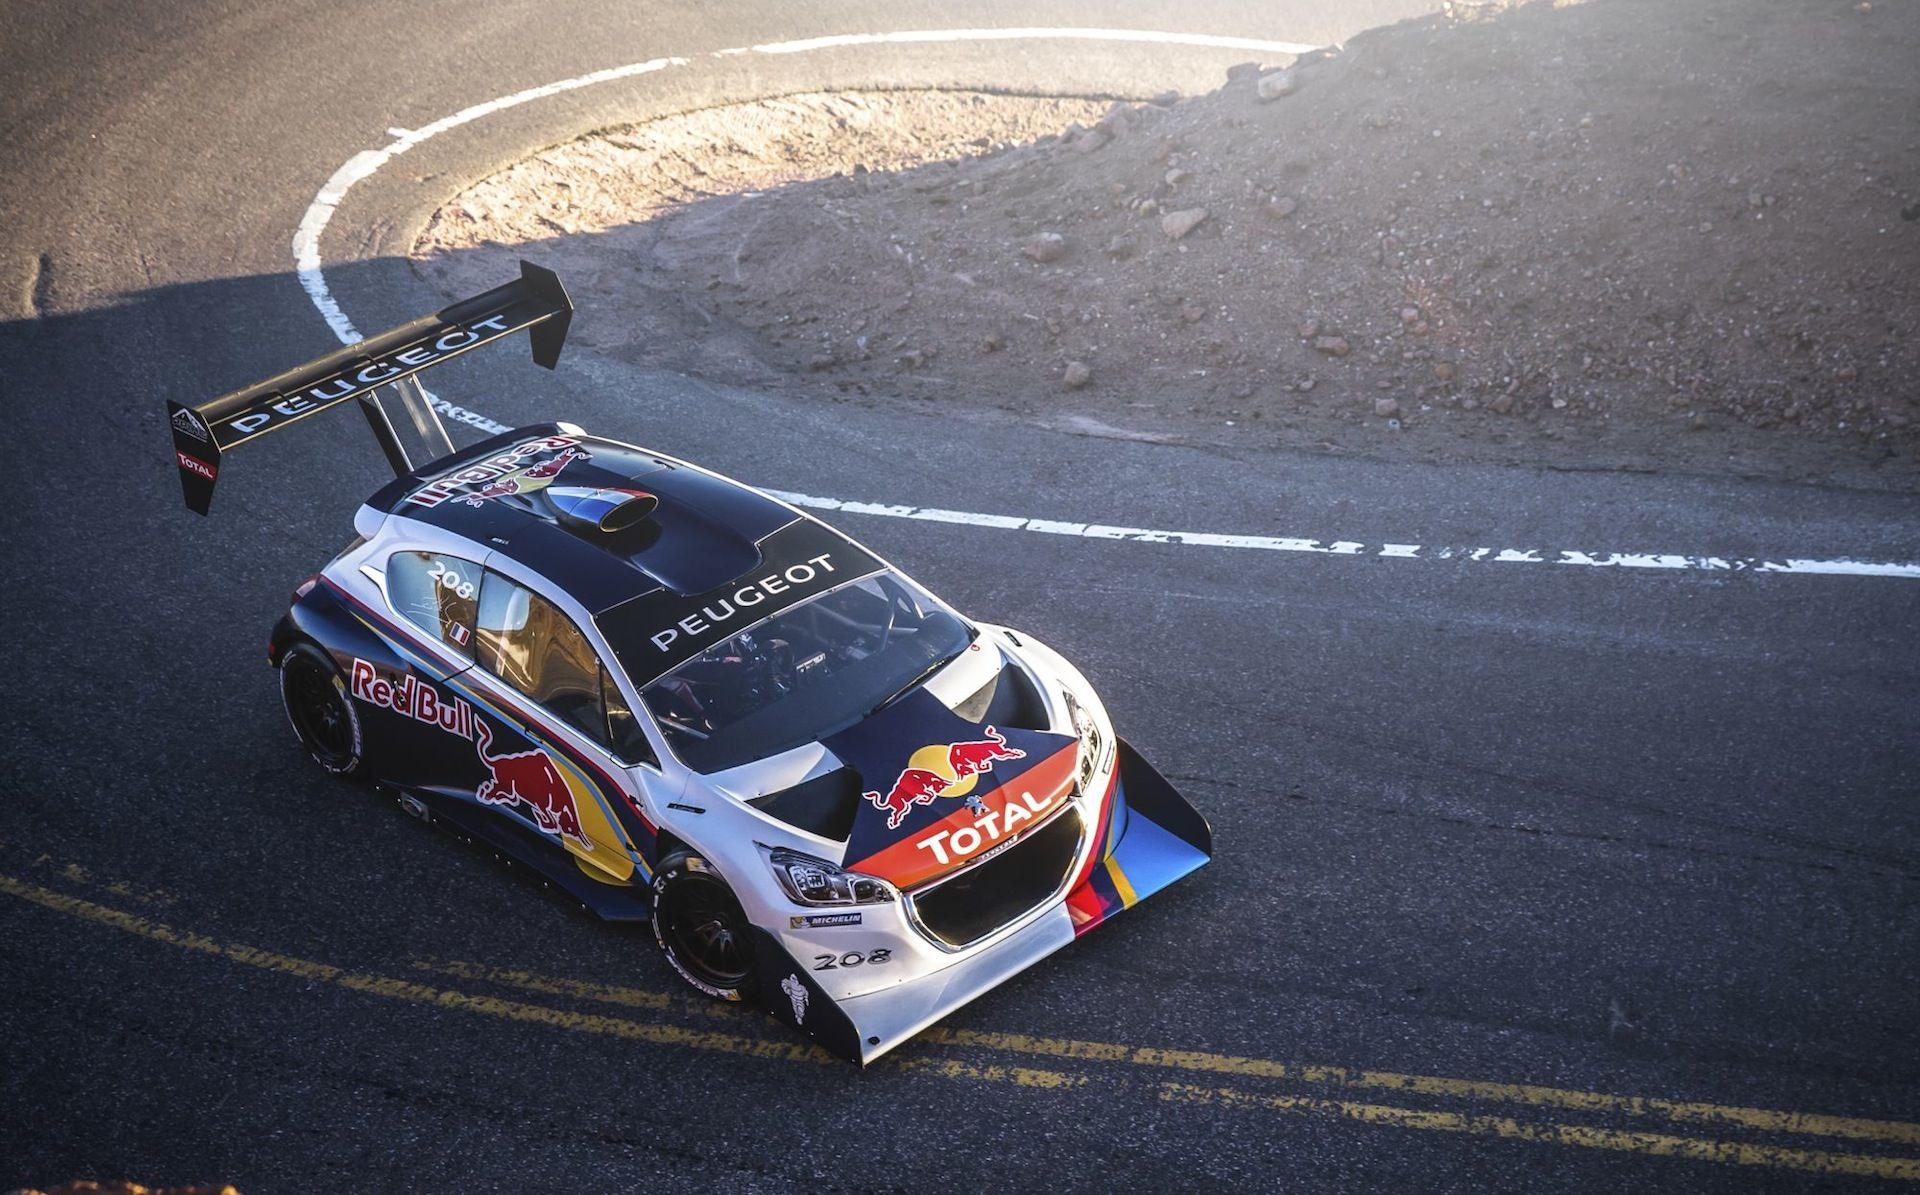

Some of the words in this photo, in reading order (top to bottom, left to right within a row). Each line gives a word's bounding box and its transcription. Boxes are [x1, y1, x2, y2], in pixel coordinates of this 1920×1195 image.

[229, 315, 508, 434] PEUGEOT
[427, 561, 474, 599] 208
[650, 553, 836, 653] PEUGEOT
[811, 914, 861, 925] MICHELIN
[814, 948, 892, 971] 208
